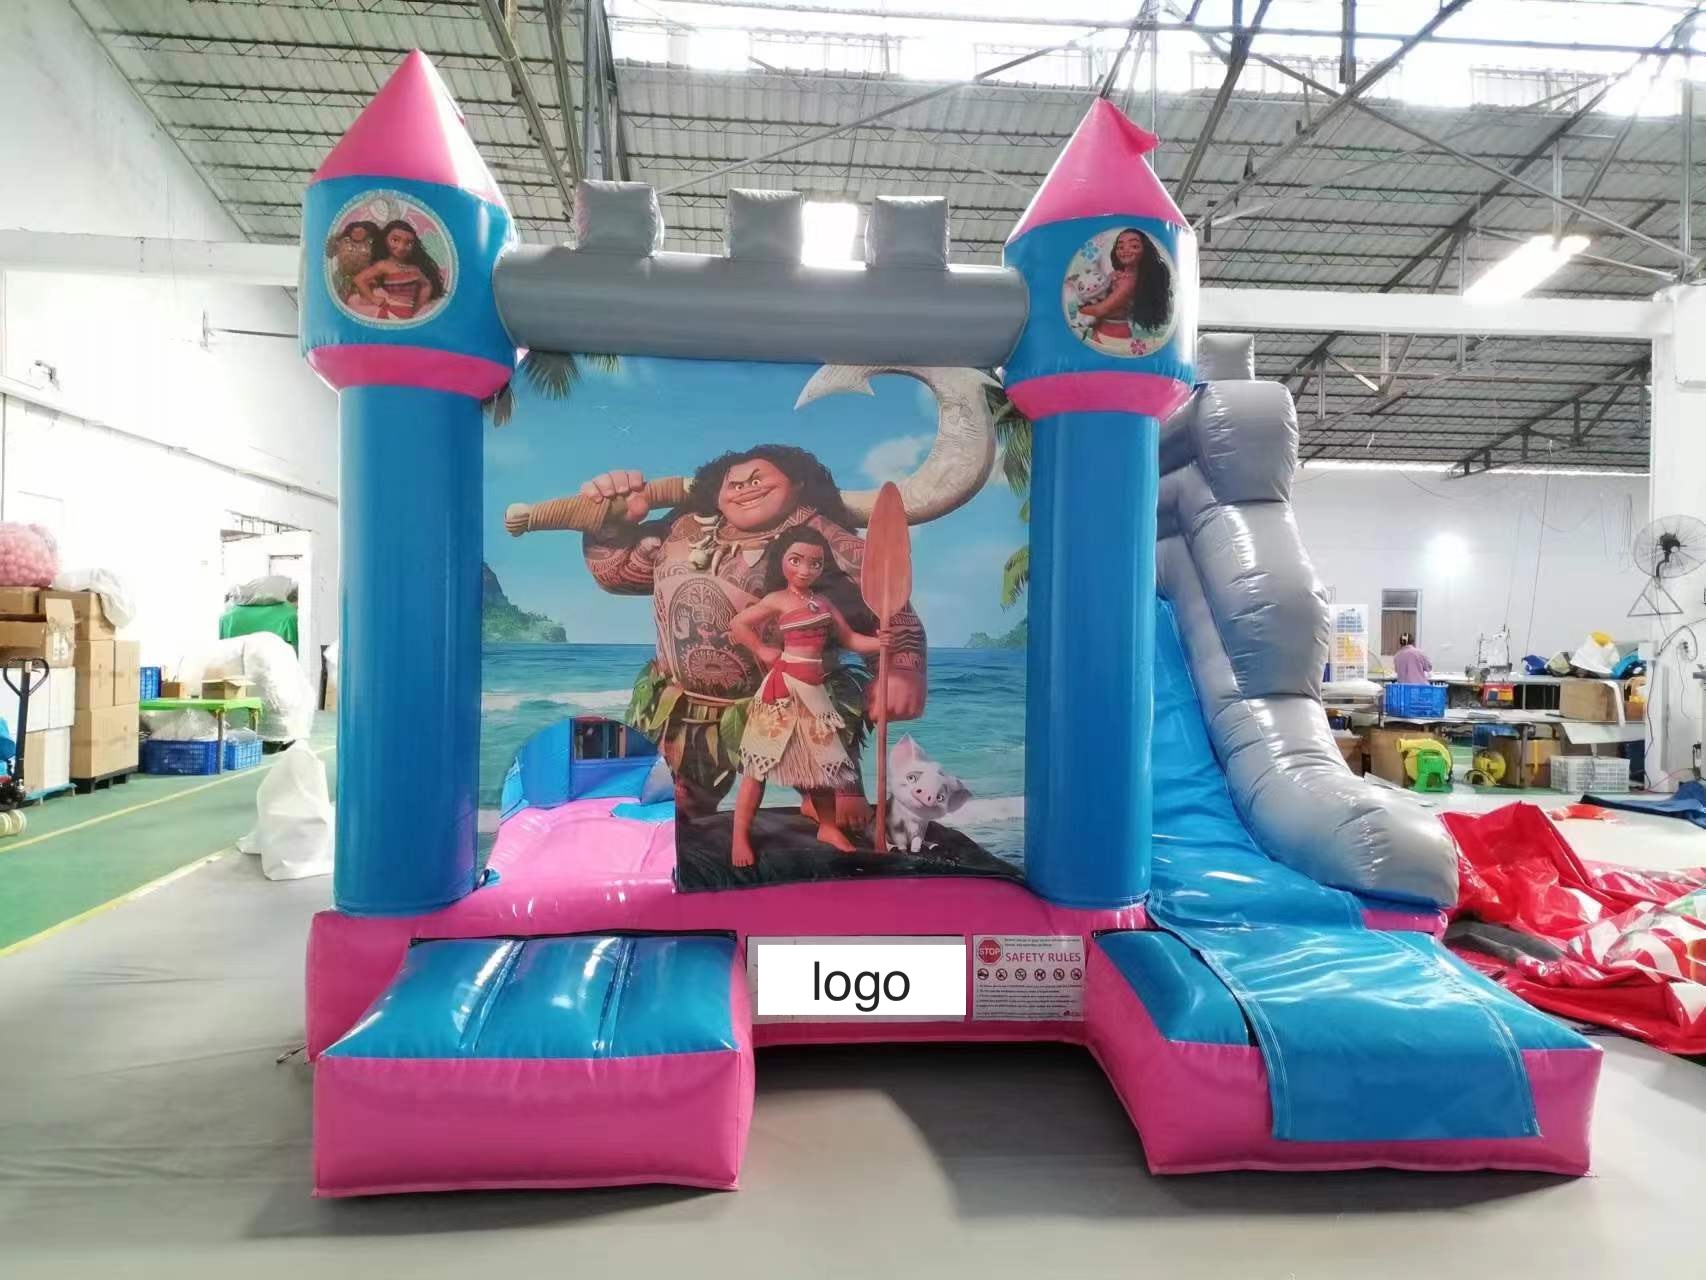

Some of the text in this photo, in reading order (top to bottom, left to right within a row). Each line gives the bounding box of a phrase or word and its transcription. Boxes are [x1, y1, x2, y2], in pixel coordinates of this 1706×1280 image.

[980, 947, 1000, 956] STOP
[1005, 952, 1081, 962] SAFETY RULES
